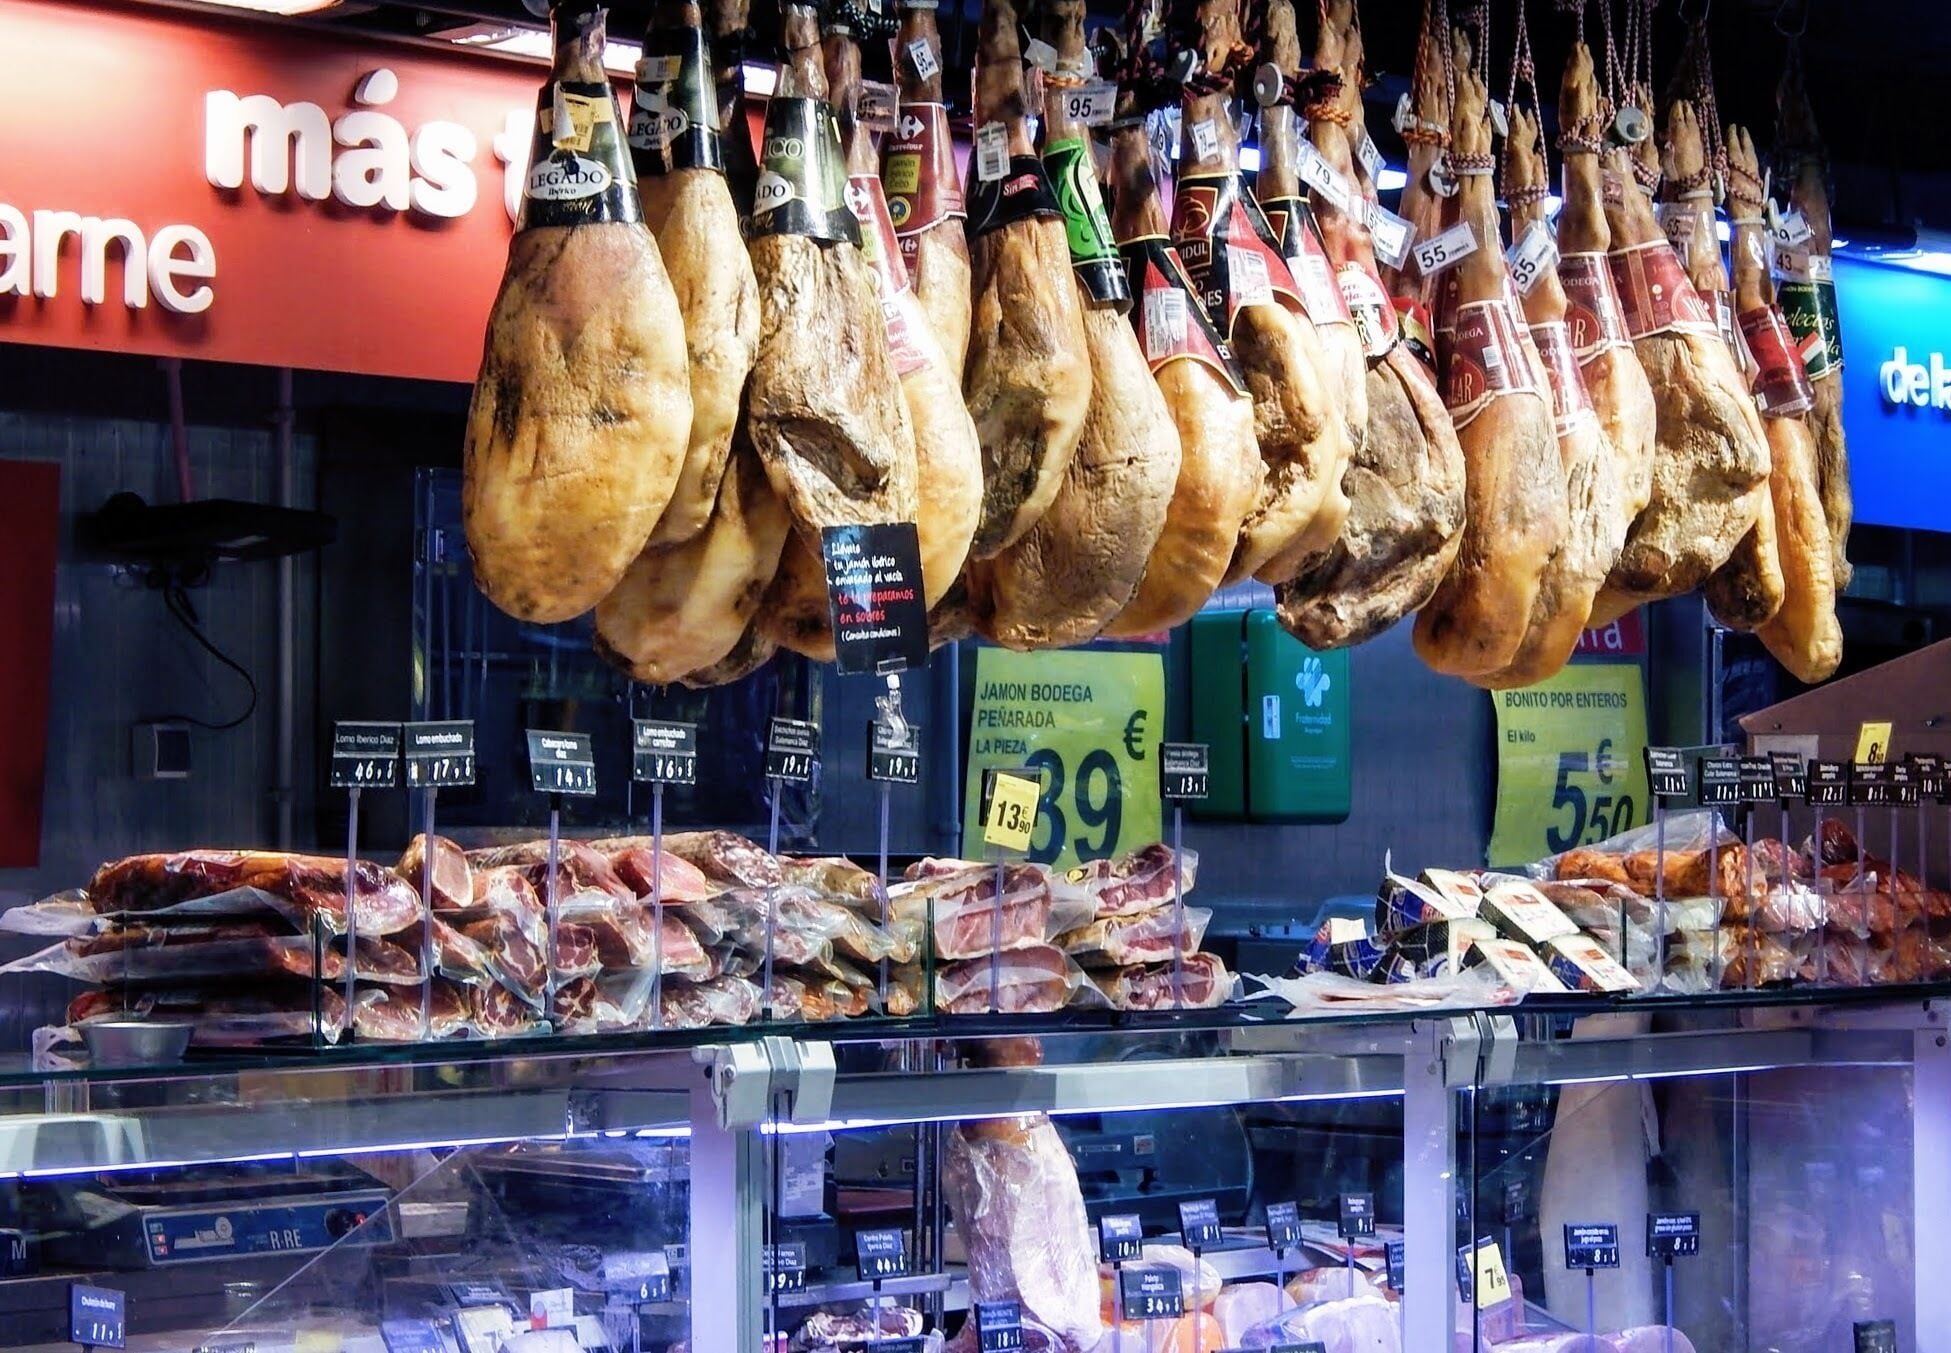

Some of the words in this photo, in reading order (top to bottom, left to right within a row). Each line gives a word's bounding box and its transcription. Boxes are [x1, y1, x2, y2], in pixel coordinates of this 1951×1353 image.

[1069, 98, 1092, 118] 95
[205, 68, 479, 218] más
[530, 169, 603, 190] LEGADO
[1315, 160, 1331, 185] 79
[1421, 245, 1447, 269] 55
[1513, 257, 1537, 286] 55
[840, 614, 852, 625] en
[856, 611, 885, 623] sobres
[980, 682, 1026, 701] JAMON
[1031, 684, 1093, 702] BODEGA
[1505, 692, 1547, 708] BONITO
[1550, 692, 1574, 708] POR
[1577, 692, 1627, 709] ENTEROS
[978, 707, 1056, 728] PEÑARADA
[336, 733, 355, 744] Lomo
[416, 734, 431, 745] Lomo
[1123, 710, 1148, 760] €
[1507, 730, 1517, 742] El
[1518, 730, 1536, 743] kilo
[976, 739, 992, 754] LA
[994, 739, 1027, 754] PIEZA
[1596, 738, 1613, 785] €
[998, 800, 1021, 830] 13
[1019, 821, 1031, 834] 90
[12, 1240, 26, 1260] M
[1485, 1267, 1495, 1290] 7
